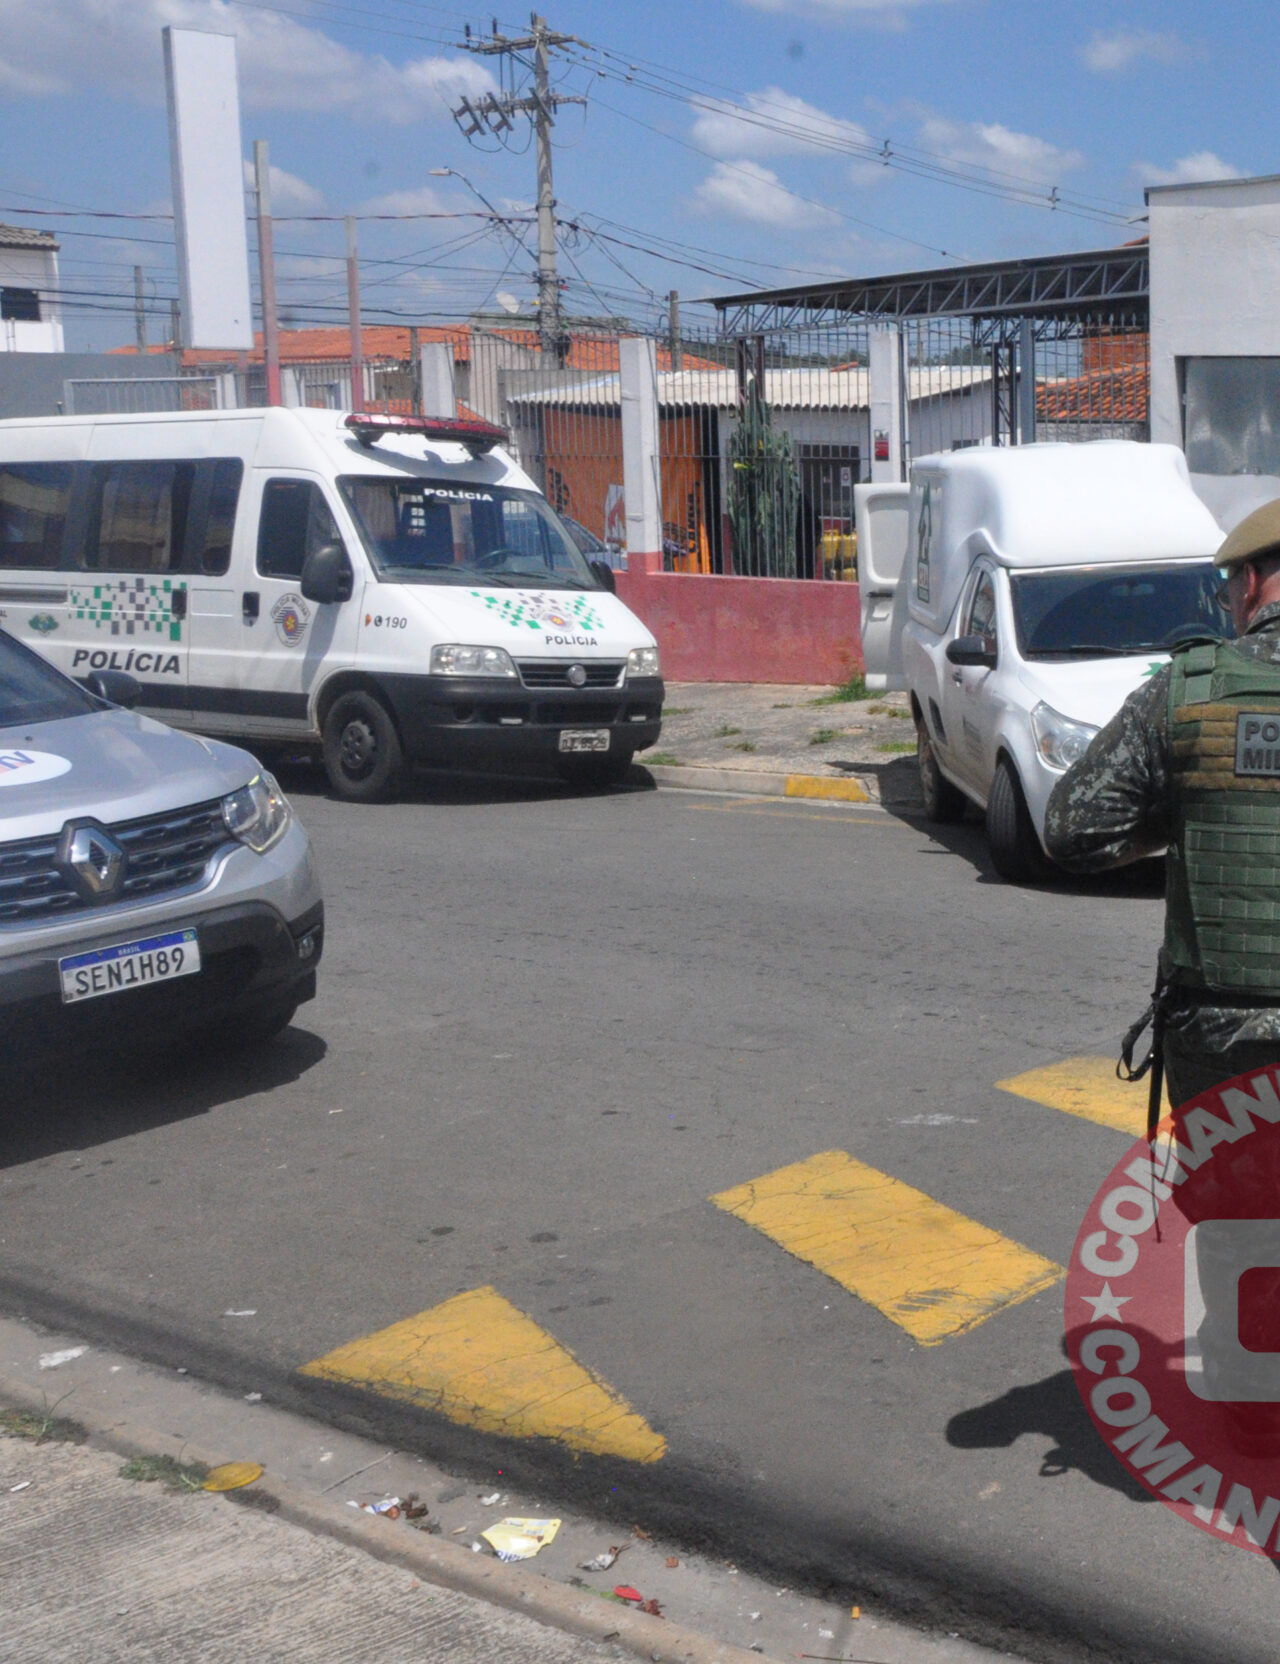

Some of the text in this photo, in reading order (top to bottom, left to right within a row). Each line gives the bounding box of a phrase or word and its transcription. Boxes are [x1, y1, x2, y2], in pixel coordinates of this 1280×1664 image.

[424, 488, 494, 502] POLÍCIA
[384, 616, 408, 630] 190
[545, 634, 598, 646] POLÍCIA
[72, 648, 181, 675] POLÍCIA
[118, 945, 141, 956] BRASIL
[75, 947, 185, 995] SEN1H89
